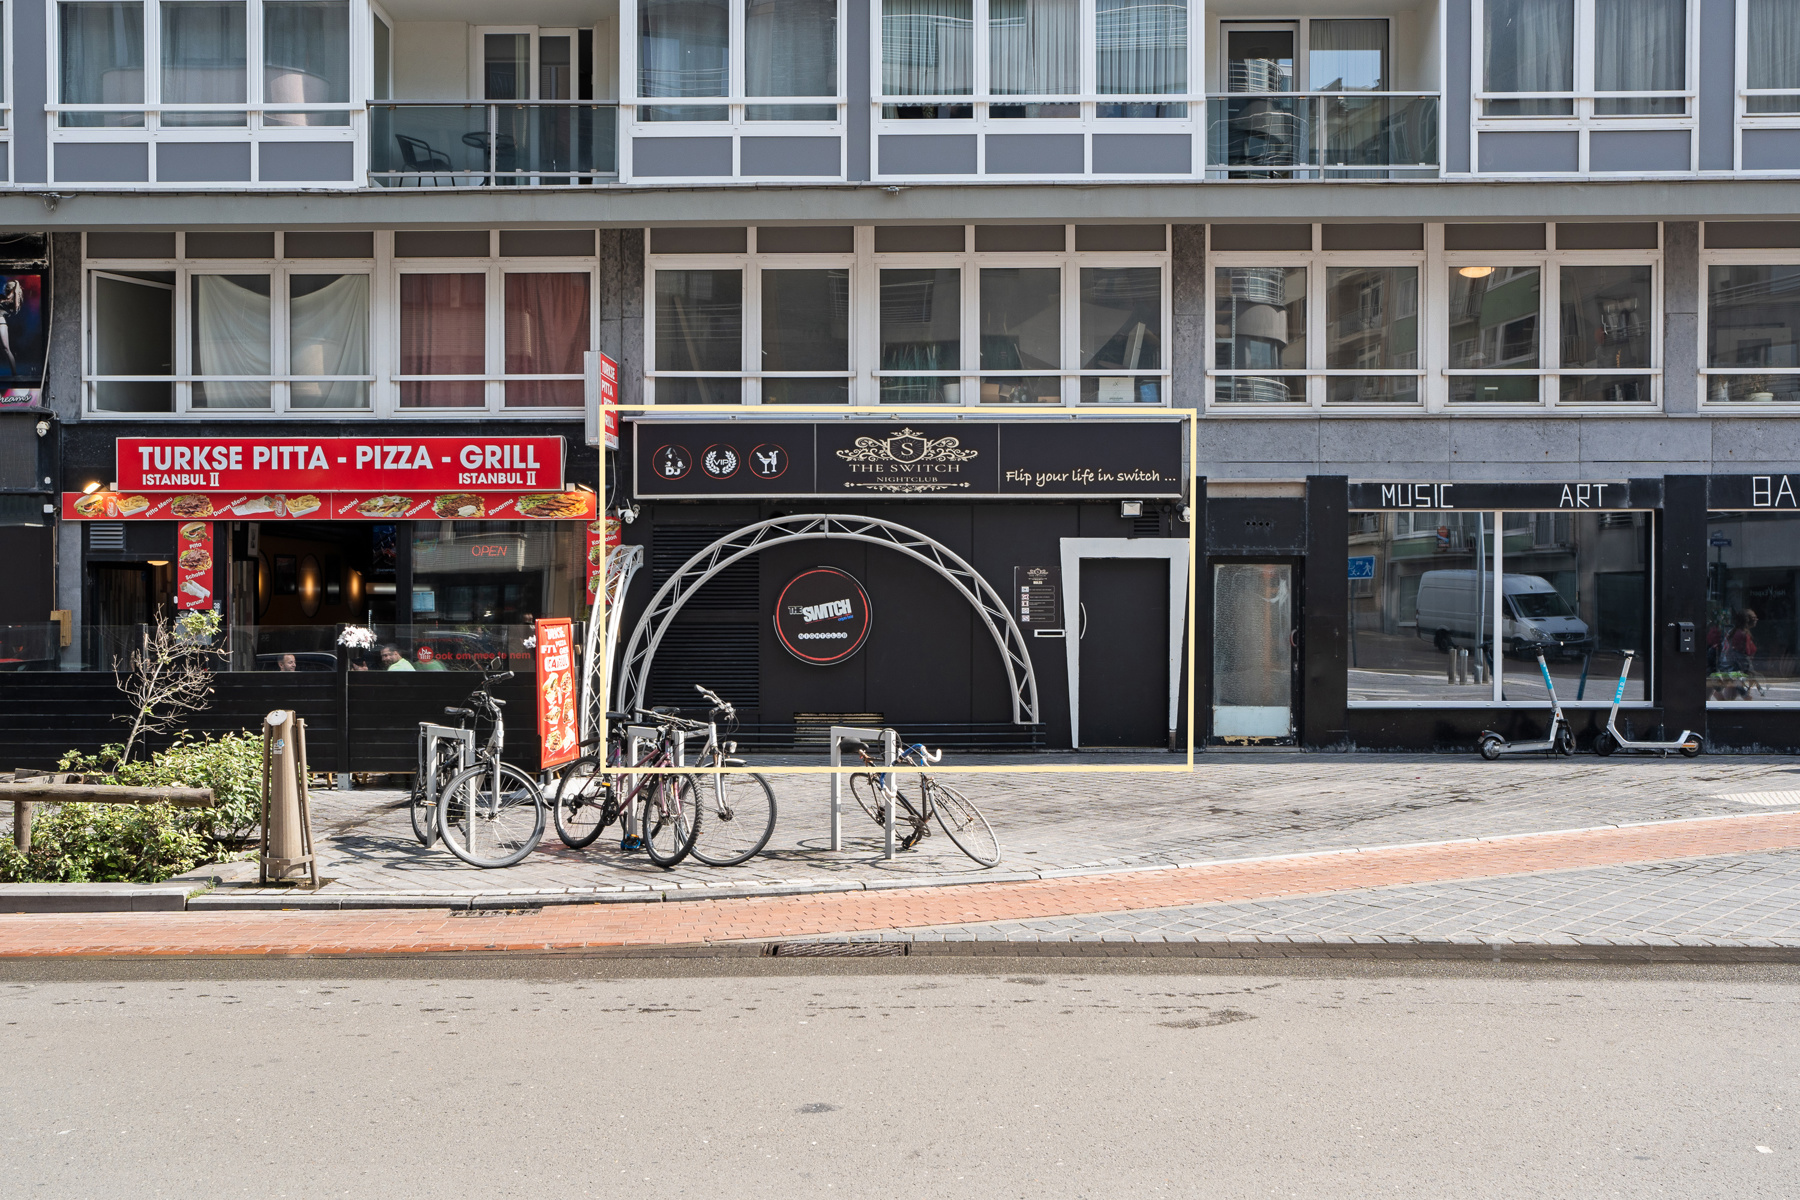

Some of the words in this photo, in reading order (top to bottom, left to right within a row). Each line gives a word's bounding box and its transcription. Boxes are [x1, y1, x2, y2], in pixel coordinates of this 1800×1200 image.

[138, 446, 242, 470] TURKSE
[253, 446, 329, 470] PITTA
[356, 445, 433, 470] PIZZA
[460, 445, 540, 469] GRILL
[901, 442, 914, 456] S
[665, 467, 681, 476] DJ
[849, 464, 884, 473] THE
[890, 464, 960, 473] SWITCH
[1006, 468, 1032, 486] Flip
[1036, 473, 1069, 487] your
[1072, 468, 1095, 485] life
[1098, 468, 1115, 482] in
[1117, 468, 1160, 482] switch
[142, 474, 207, 486] ISTANBUL
[458, 473, 523, 485] ISTANBUL
[1381, 484, 1454, 508] MUSIC
[1559, 484, 1609, 508] ART
[145, 507, 159, 518] Pitta
[158, 497, 173, 509] Menu
[213, 504, 232, 517] Durum
[231, 496, 247, 507] Menu
[488, 498, 514, 516] Shoarma
[471, 545, 508, 557] OPEN
[788, 606, 803, 615] THE
[802, 598, 852, 622] SWITCH
[435, 651, 454, 660] ook
[1616, 681, 1625, 699] BIRD
